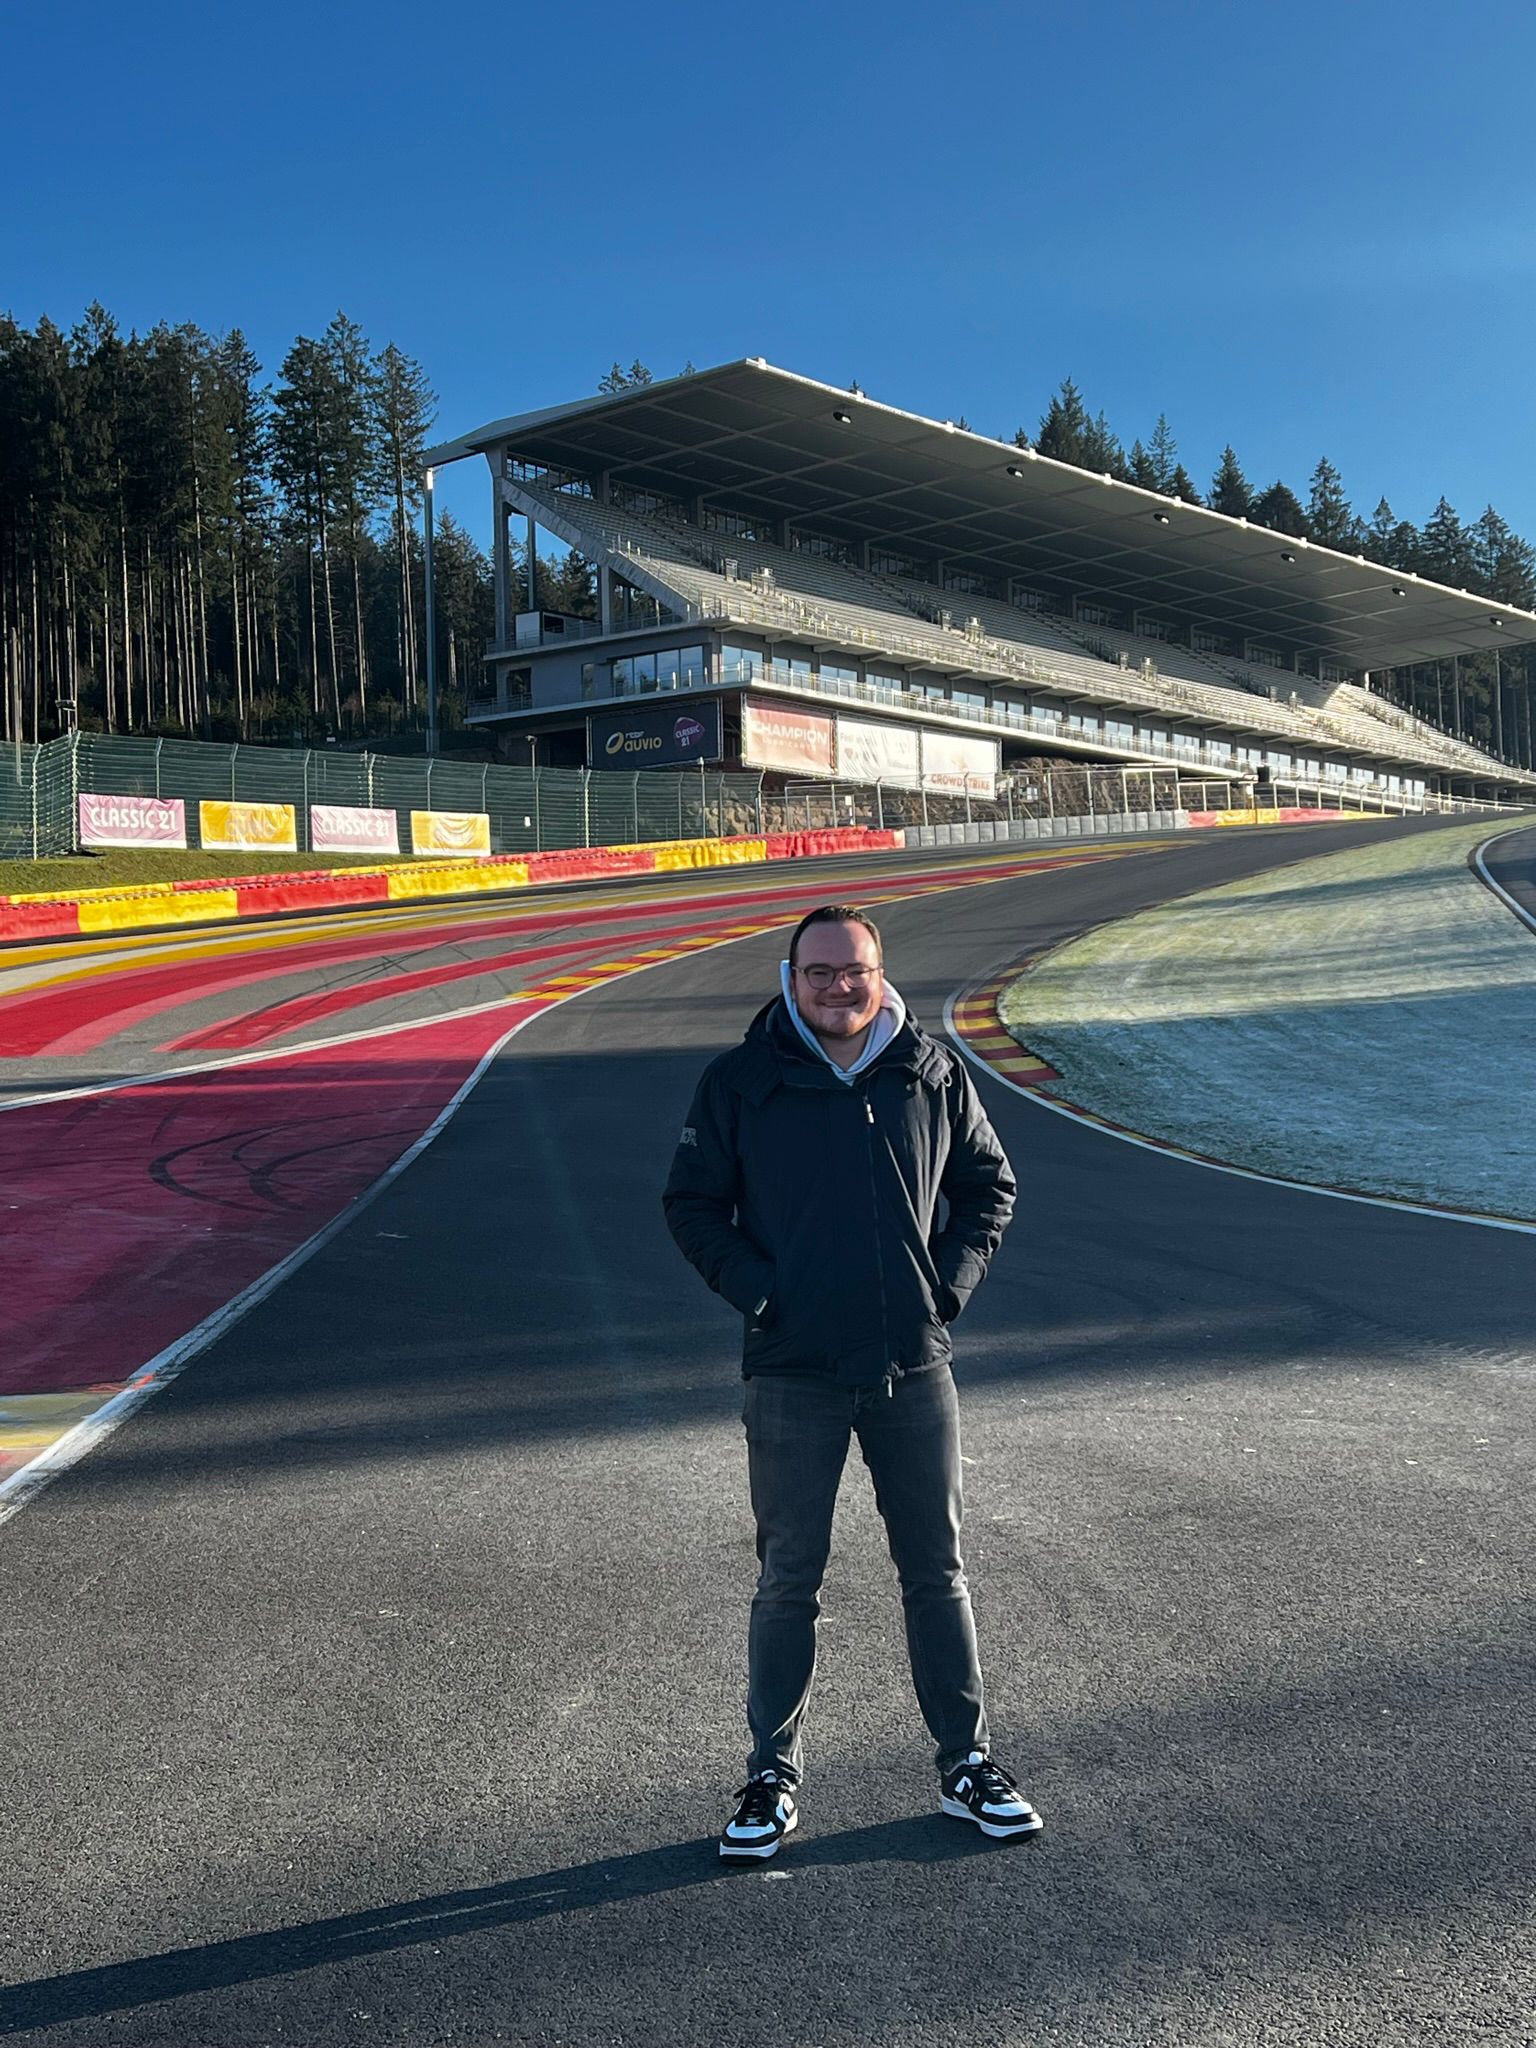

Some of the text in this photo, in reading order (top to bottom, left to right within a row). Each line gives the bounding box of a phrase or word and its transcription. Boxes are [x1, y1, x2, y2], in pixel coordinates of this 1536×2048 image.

[675, 725, 700, 738] CLASSIC
[752, 721, 828, 745] CHAMPION
[682, 736, 691, 747] 21
[931, 773, 990, 791] CROWDTRIKE
[91, 806, 176, 830] CLASSIC 21
[322, 818, 389, 837] CLASSIC 21
